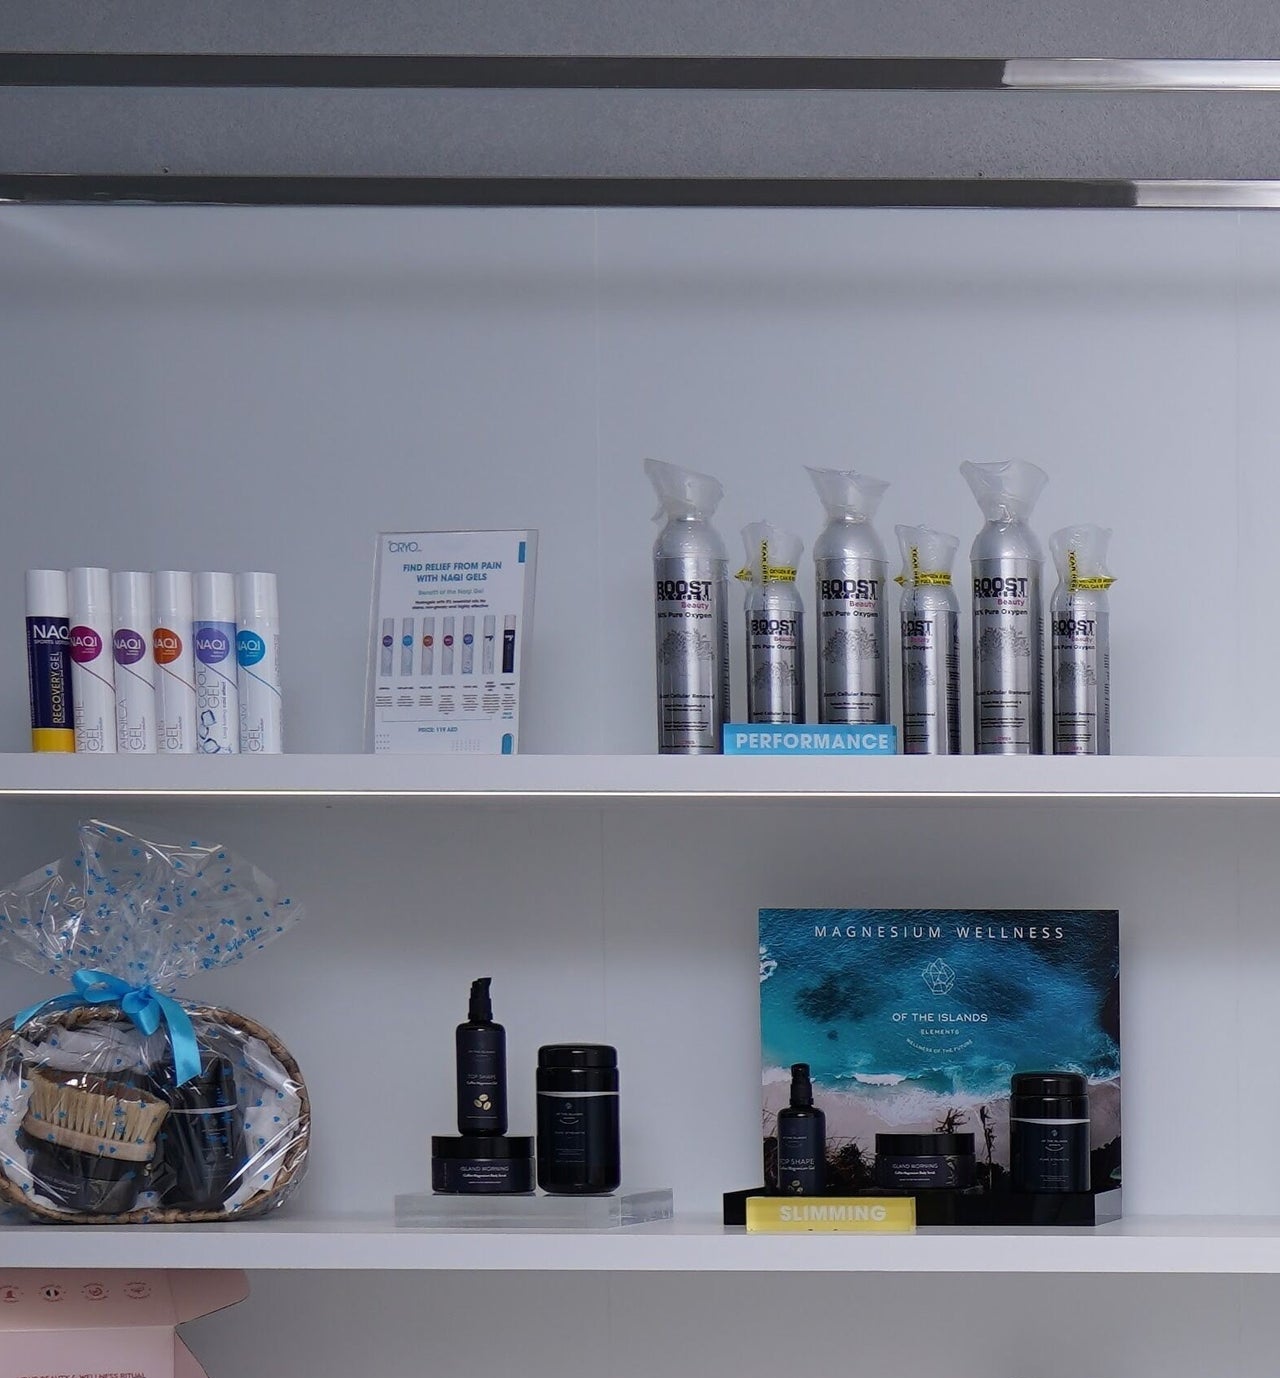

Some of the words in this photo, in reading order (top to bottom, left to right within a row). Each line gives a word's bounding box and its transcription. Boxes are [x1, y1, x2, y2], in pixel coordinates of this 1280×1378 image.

[403, 564, 422, 572] FIND
[426, 563, 451, 571] RELIEF
[454, 562, 478, 570] FROM
[482, 561, 502, 570] PAIN
[417, 574, 438, 582] WITH
[466, 573, 487, 581] GELS
[657, 581, 712, 595] BOOST
[822, 580, 878, 593] BOOST
[974, 578, 1028, 592] BOOST
[114, 639, 141, 649] NAQI
[197, 640, 226, 650] NAQI
[130, 720, 142, 750] GEL
[736, 734, 888, 749] PERFORMANCE
[815, 926, 941, 938] MAGNESIUM
[957, 927, 1064, 939] WELLNESS
[893, 1013, 907, 1022] OF
[912, 1013, 934, 1022] THE
[939, 1013, 987, 1022] ISLANDS
[779, 1206, 886, 1222] SLIMMING
